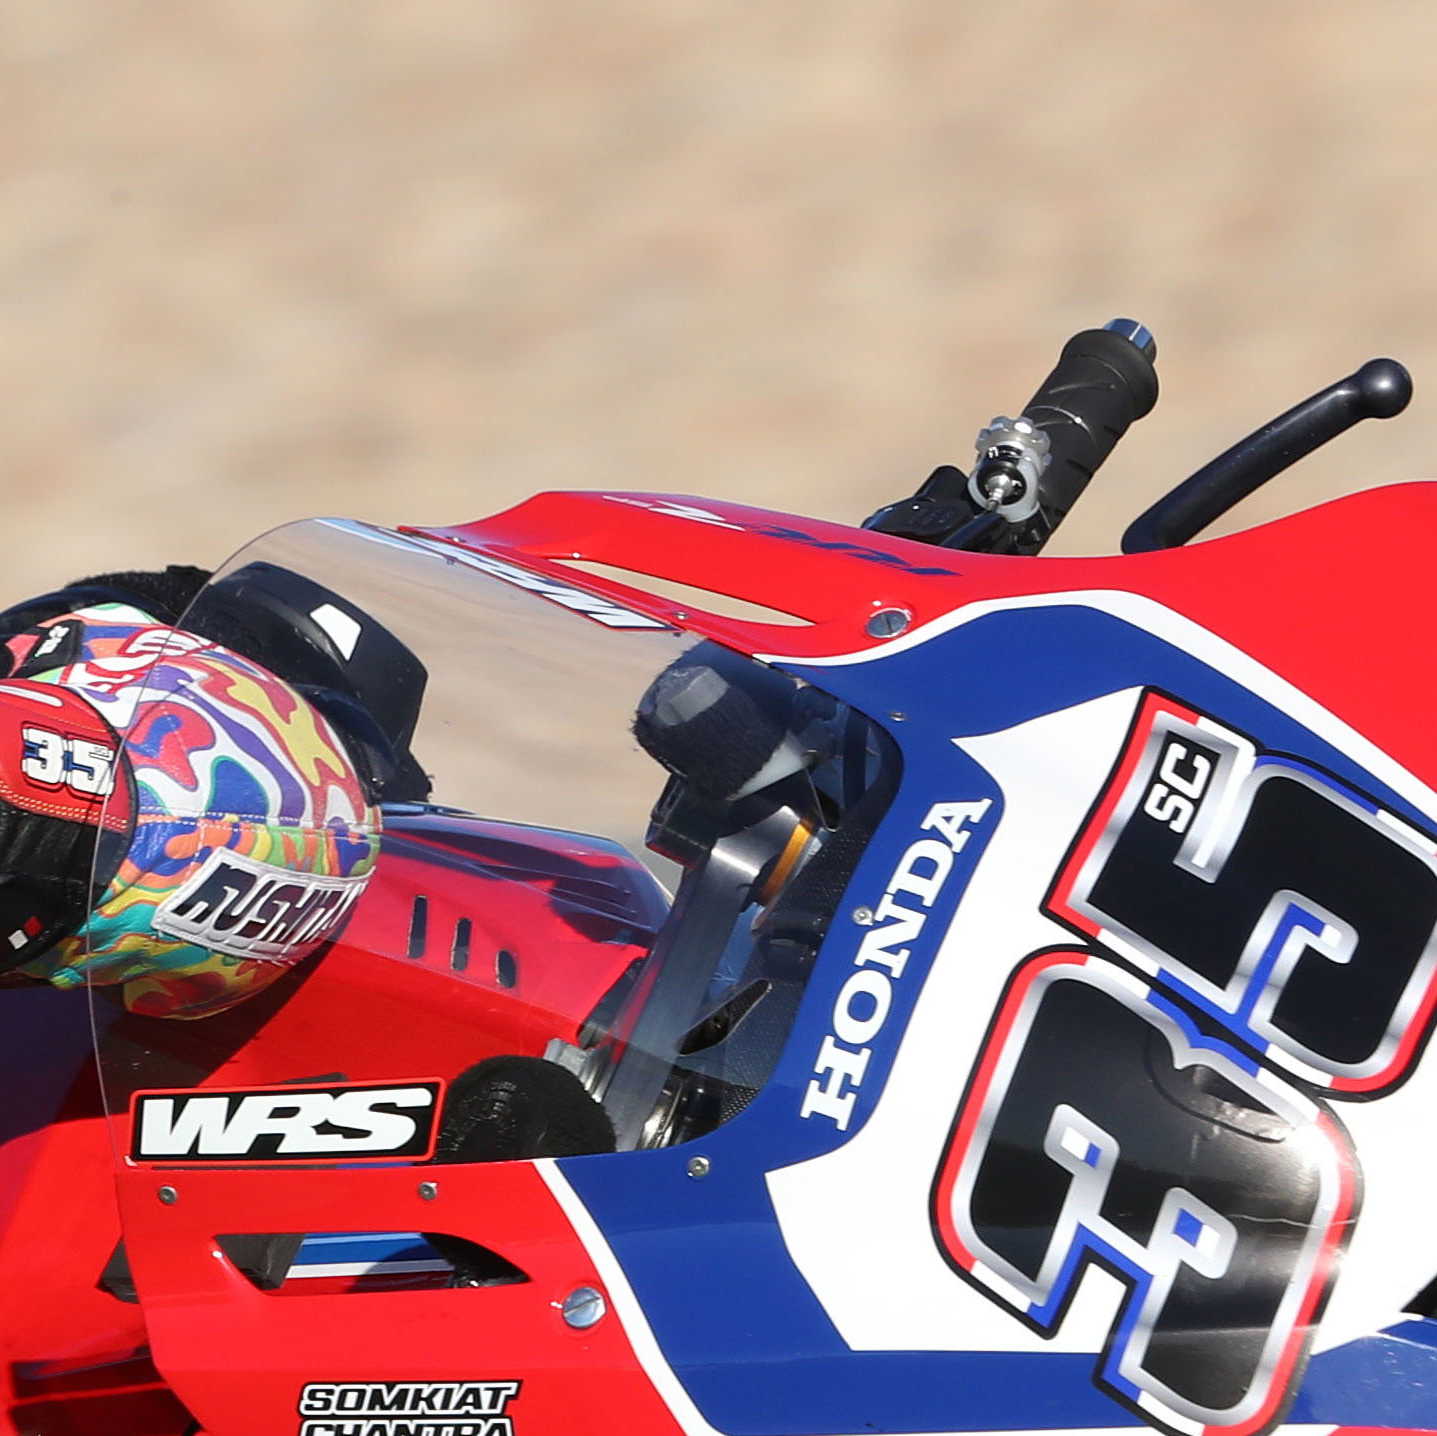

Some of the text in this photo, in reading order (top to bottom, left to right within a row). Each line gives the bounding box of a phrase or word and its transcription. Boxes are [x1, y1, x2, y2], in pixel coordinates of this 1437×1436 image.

[21, 727, 115, 796] 35
[1143, 741, 1215, 835] SC
[800, 797, 993, 1132] HONDA
[140, 1087, 433, 1156] WRS
[300, 1383, 520, 1415] SOMKIAT
